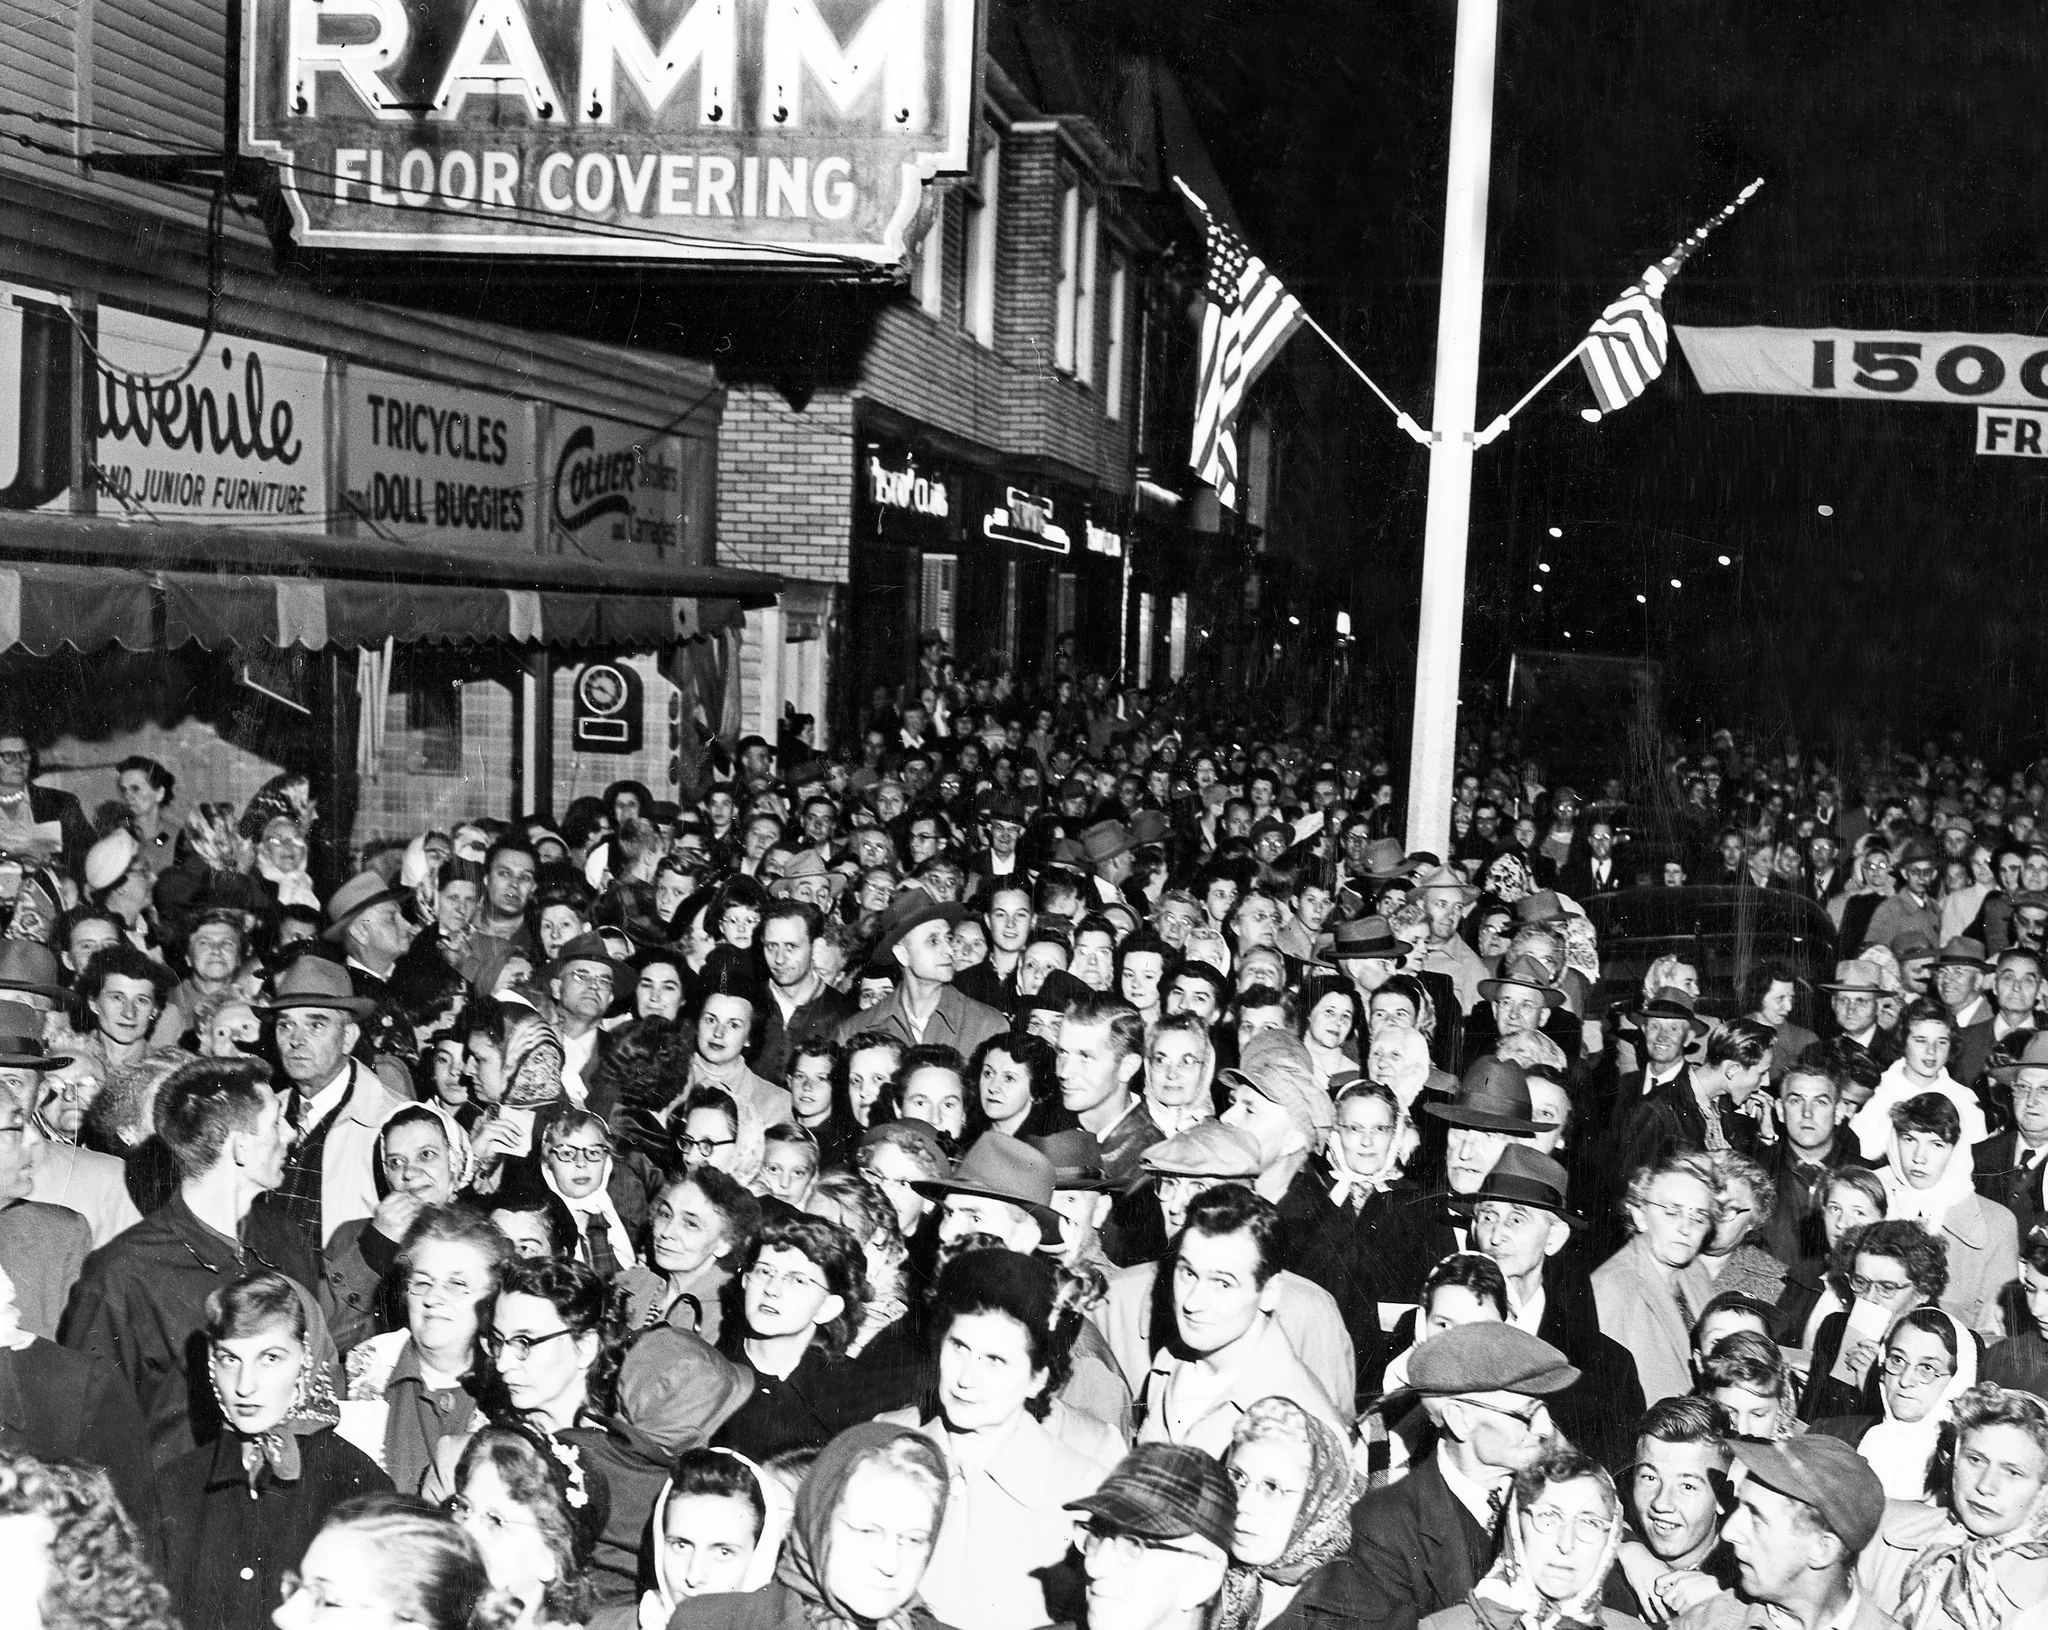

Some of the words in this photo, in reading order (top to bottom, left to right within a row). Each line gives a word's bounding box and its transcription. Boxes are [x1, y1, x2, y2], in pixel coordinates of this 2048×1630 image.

[287, 0, 924, 129] RAMM
[335, 148, 519, 209] FLOOR
[538, 152, 858, 220] COVERING
[367, 394, 508, 466] TRICYCLES
[135, 467, 206, 506] JUNIOR
[212, 476, 308, 515] FURNITURE
[373, 471, 428, 524] DOLL
[435, 481, 524, 533] BUGGIES
